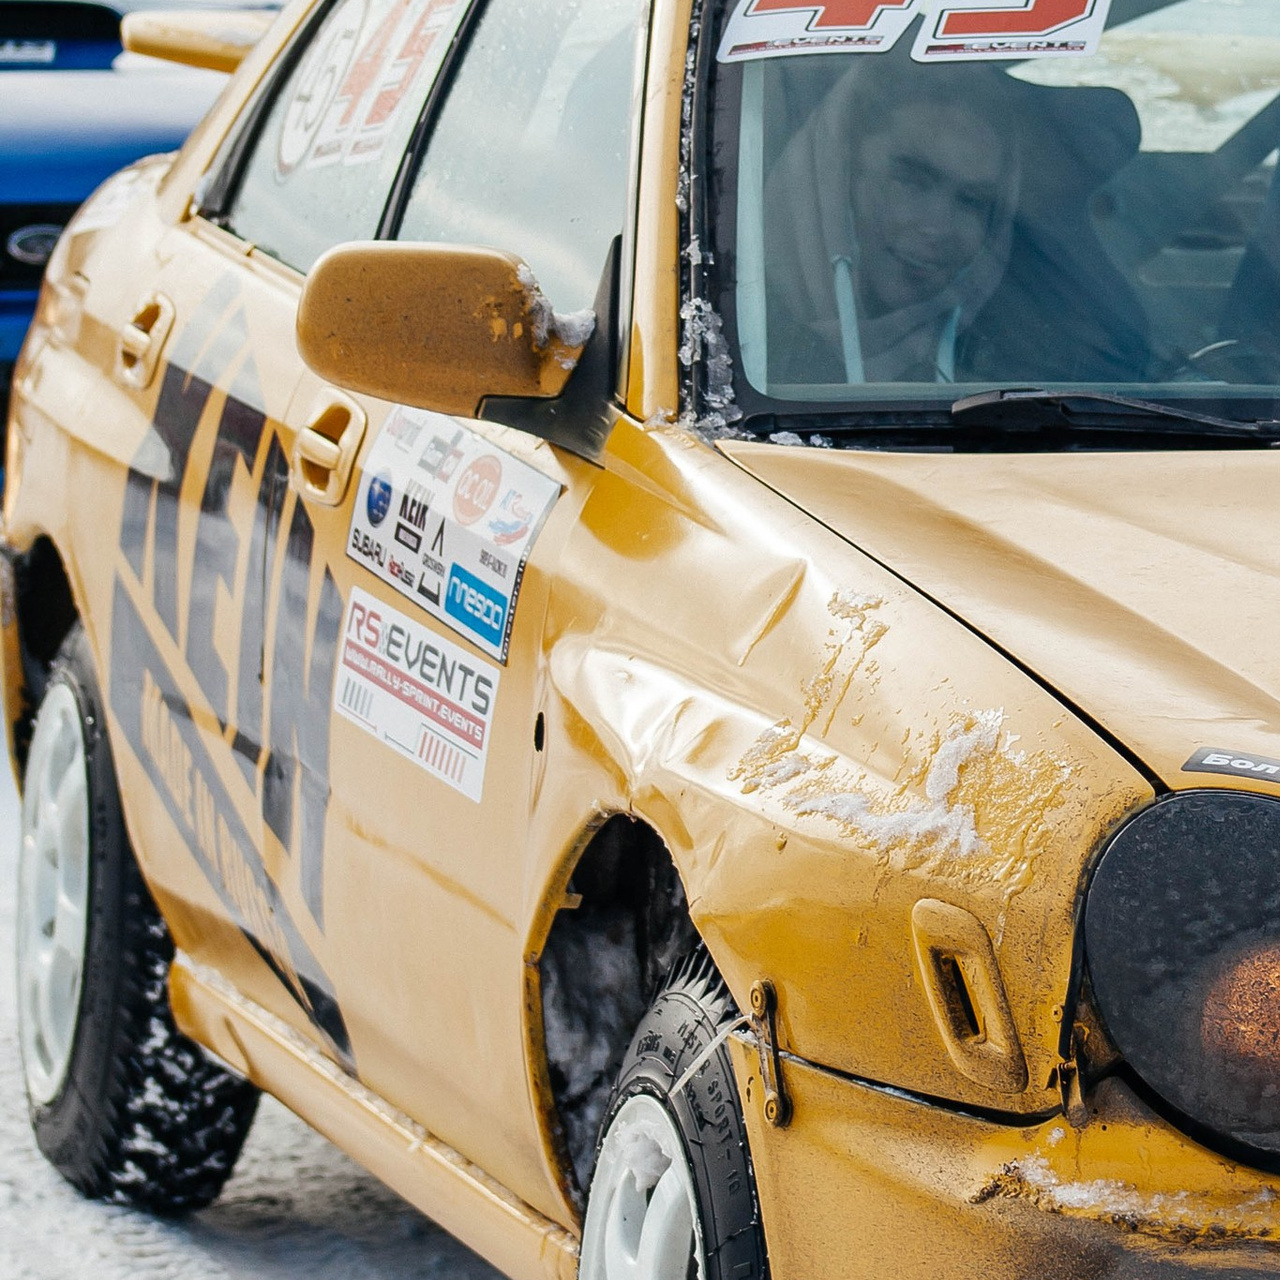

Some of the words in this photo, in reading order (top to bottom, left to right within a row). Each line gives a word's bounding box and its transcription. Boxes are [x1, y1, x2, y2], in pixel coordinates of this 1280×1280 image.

[352, 528, 387, 569] SUBARU
[348, 601, 382, 649] RS
[386, 623, 493, 716] EVENTS
